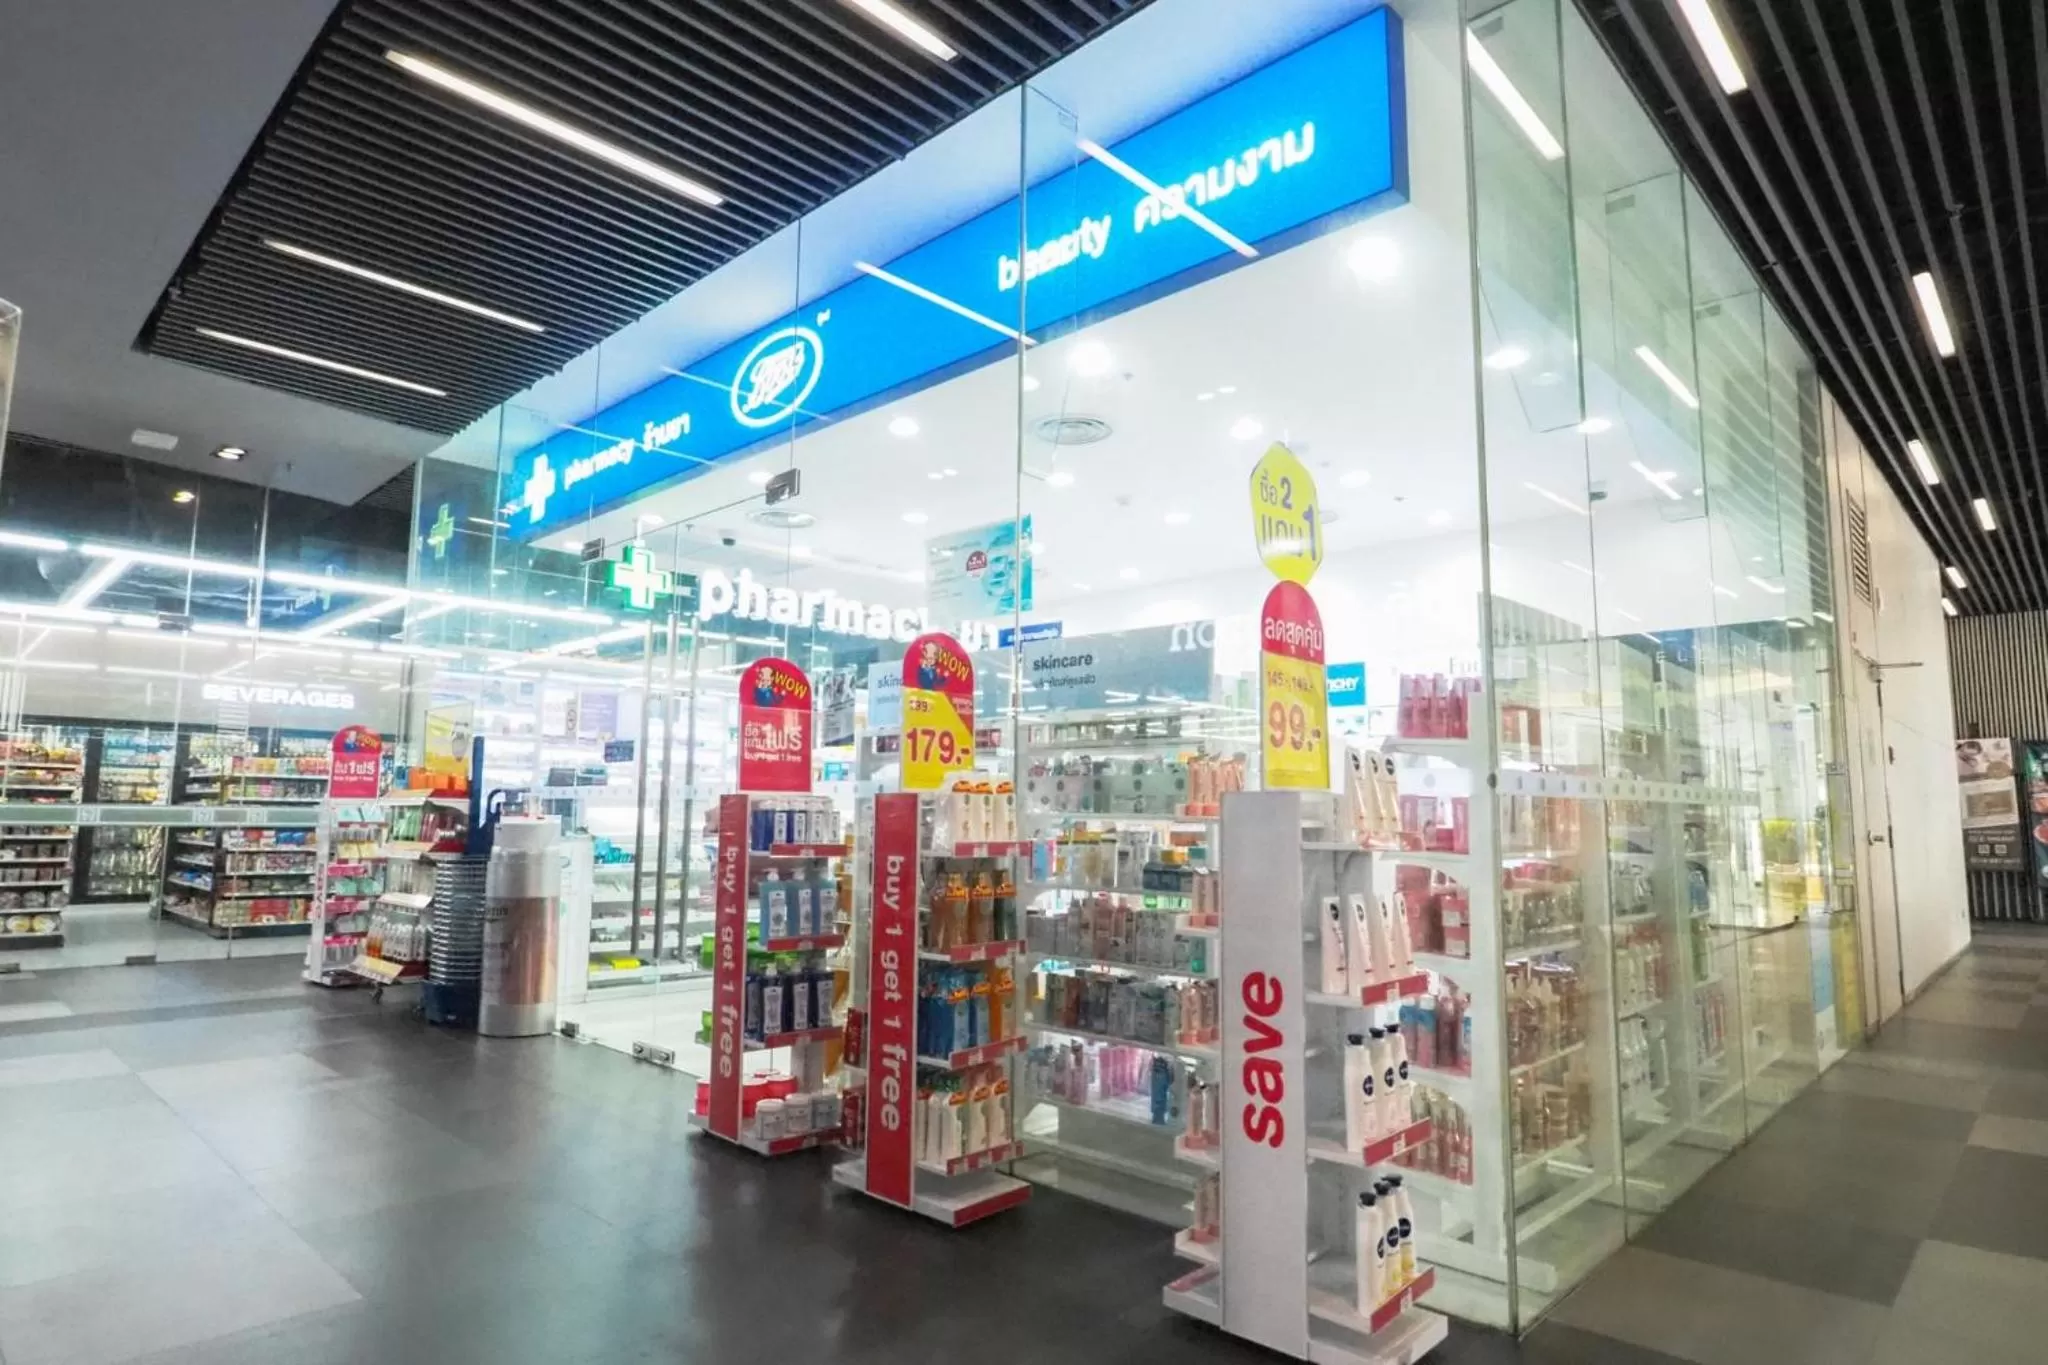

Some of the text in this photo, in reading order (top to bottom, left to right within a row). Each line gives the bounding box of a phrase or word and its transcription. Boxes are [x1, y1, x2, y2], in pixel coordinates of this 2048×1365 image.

[997, 214, 1111, 291] beauty
[564, 438, 634, 490] pharmacy
[1281, 476, 1292, 509] 2
[1302, 503, 1316, 561] 1
[773, 670, 808, 699] WOW
[938, 648, 970, 683] WOW
[1032, 653, 1093, 671] skincare
[203, 683, 355, 709] BEVERAGES
[906, 727, 971, 765] 179.-
[719, 845, 739, 1079] buy 1 get 1 free
[880, 855, 908, 1132] buy 1 get 1 free
[1242, 970, 1285, 1149] save
